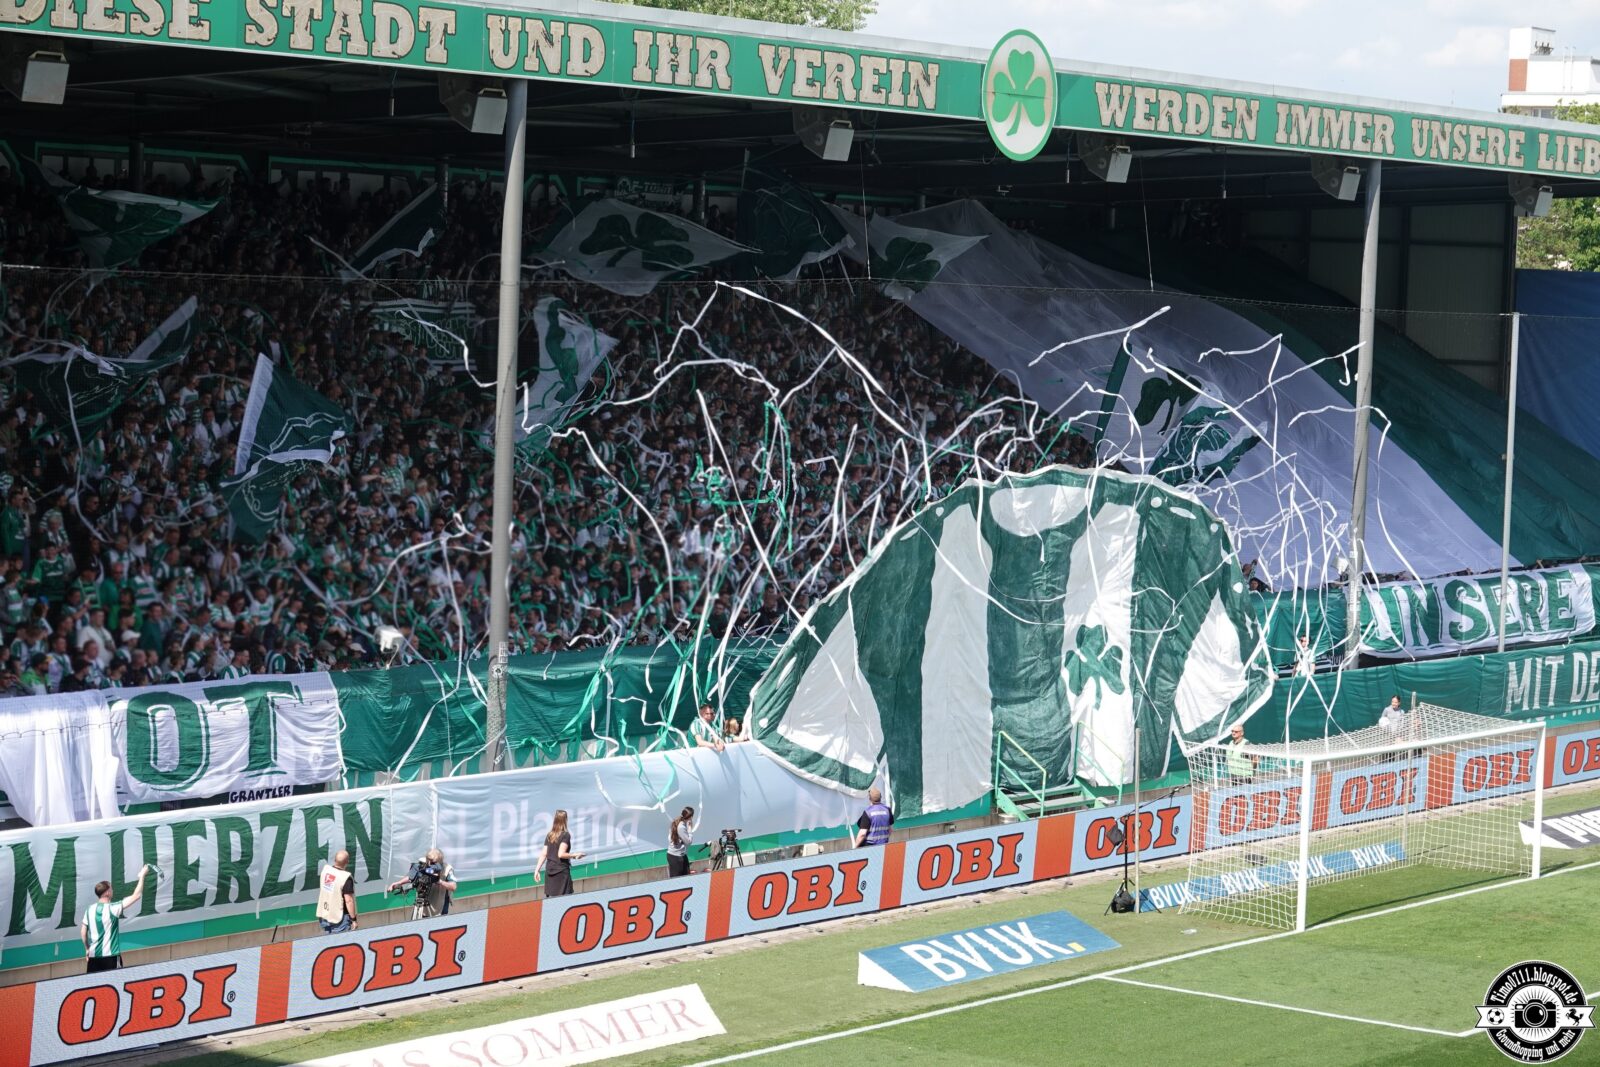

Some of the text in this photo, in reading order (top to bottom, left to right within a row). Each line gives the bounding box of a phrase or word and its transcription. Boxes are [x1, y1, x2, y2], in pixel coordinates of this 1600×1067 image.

[244, 0, 456, 64] STADT
[485, 13, 606, 77] UND
[632, 28, 732, 91] IHR
[758, 43, 940, 110] VEREIN
[1095, 82, 1260, 142] WERDEN
[1275, 102, 1396, 155] IMMER
[1411, 118, 1526, 168] UNSERE
[1359, 569, 1577, 650] UNSERE
[1505, 655, 1564, 713] MIT
[230, 785, 291, 803] GRANTLER
[491, 800, 642, 865] Plama
[0, 835, 80, 938] M
[105, 797, 386, 920] HERZEN
[449, 998, 704, 1067] SOMMER
